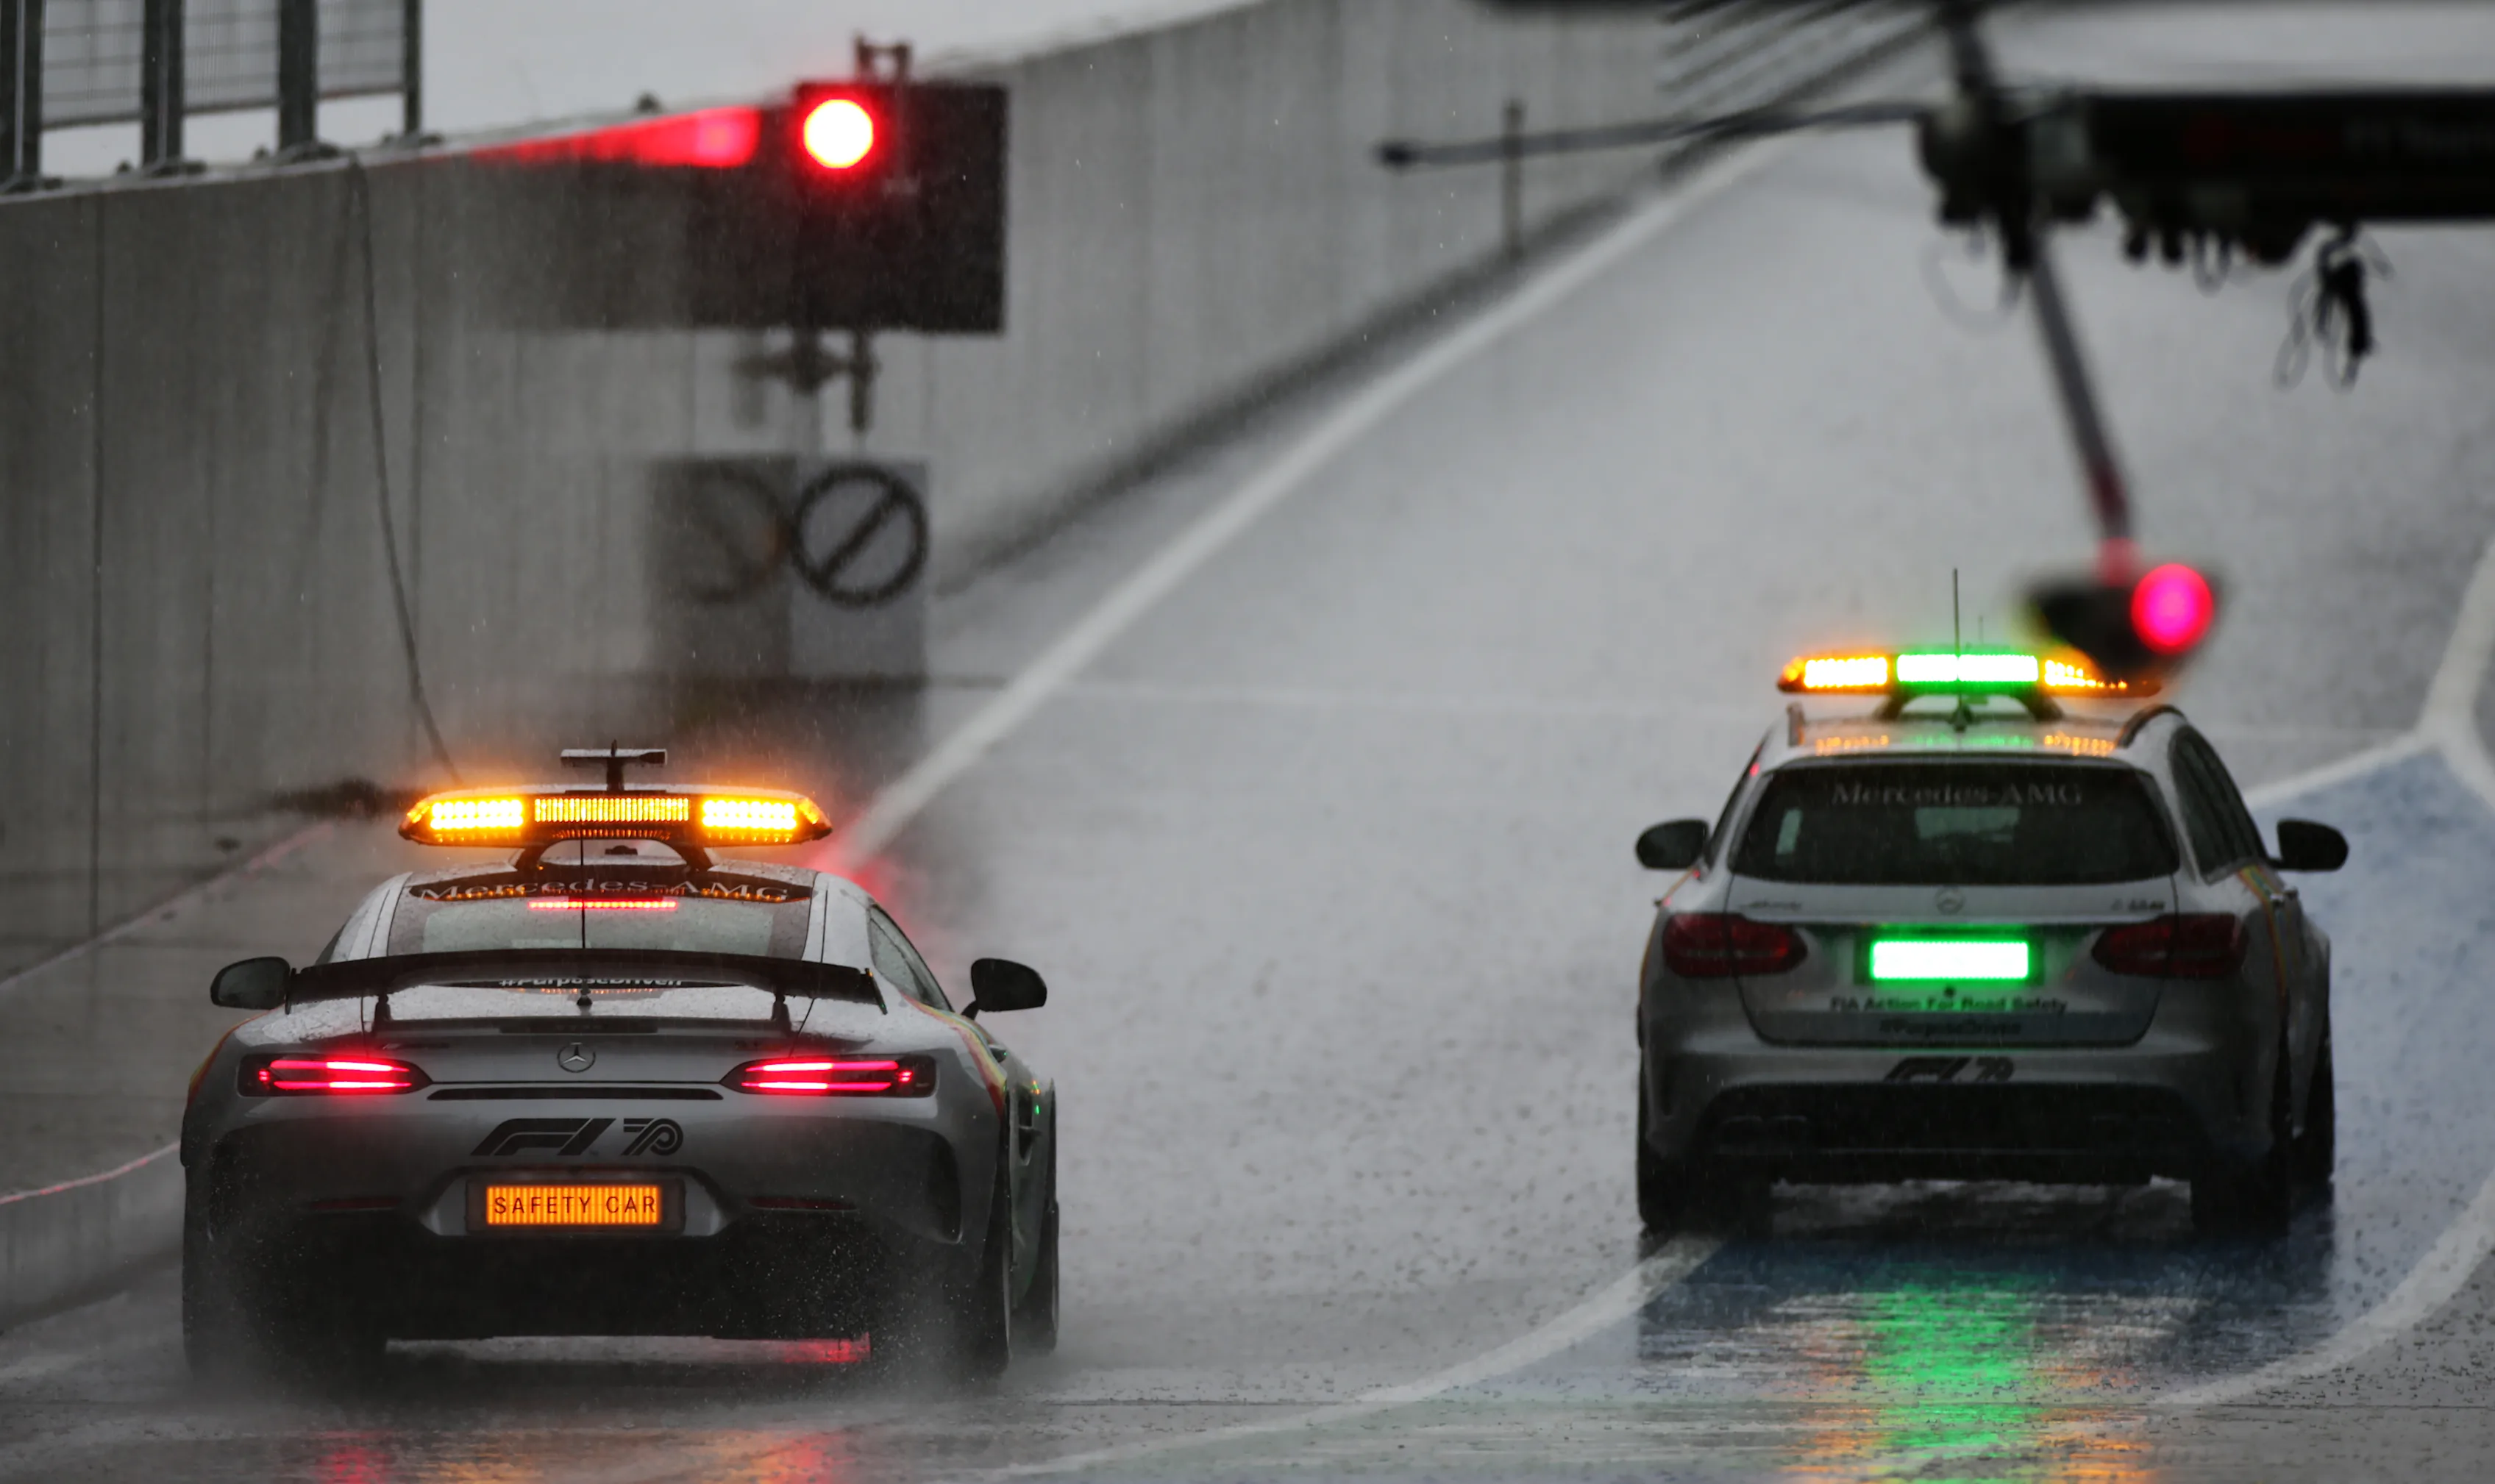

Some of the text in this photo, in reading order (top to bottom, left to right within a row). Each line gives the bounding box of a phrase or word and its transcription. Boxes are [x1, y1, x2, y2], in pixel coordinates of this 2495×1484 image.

[1831, 782, 2082, 805] Mercedes-AMG
[421, 878, 789, 901] Mercedes-AMG
[470, 1118, 616, 1156] F1
[494, 1196, 657, 1214] SAFETY CAR
